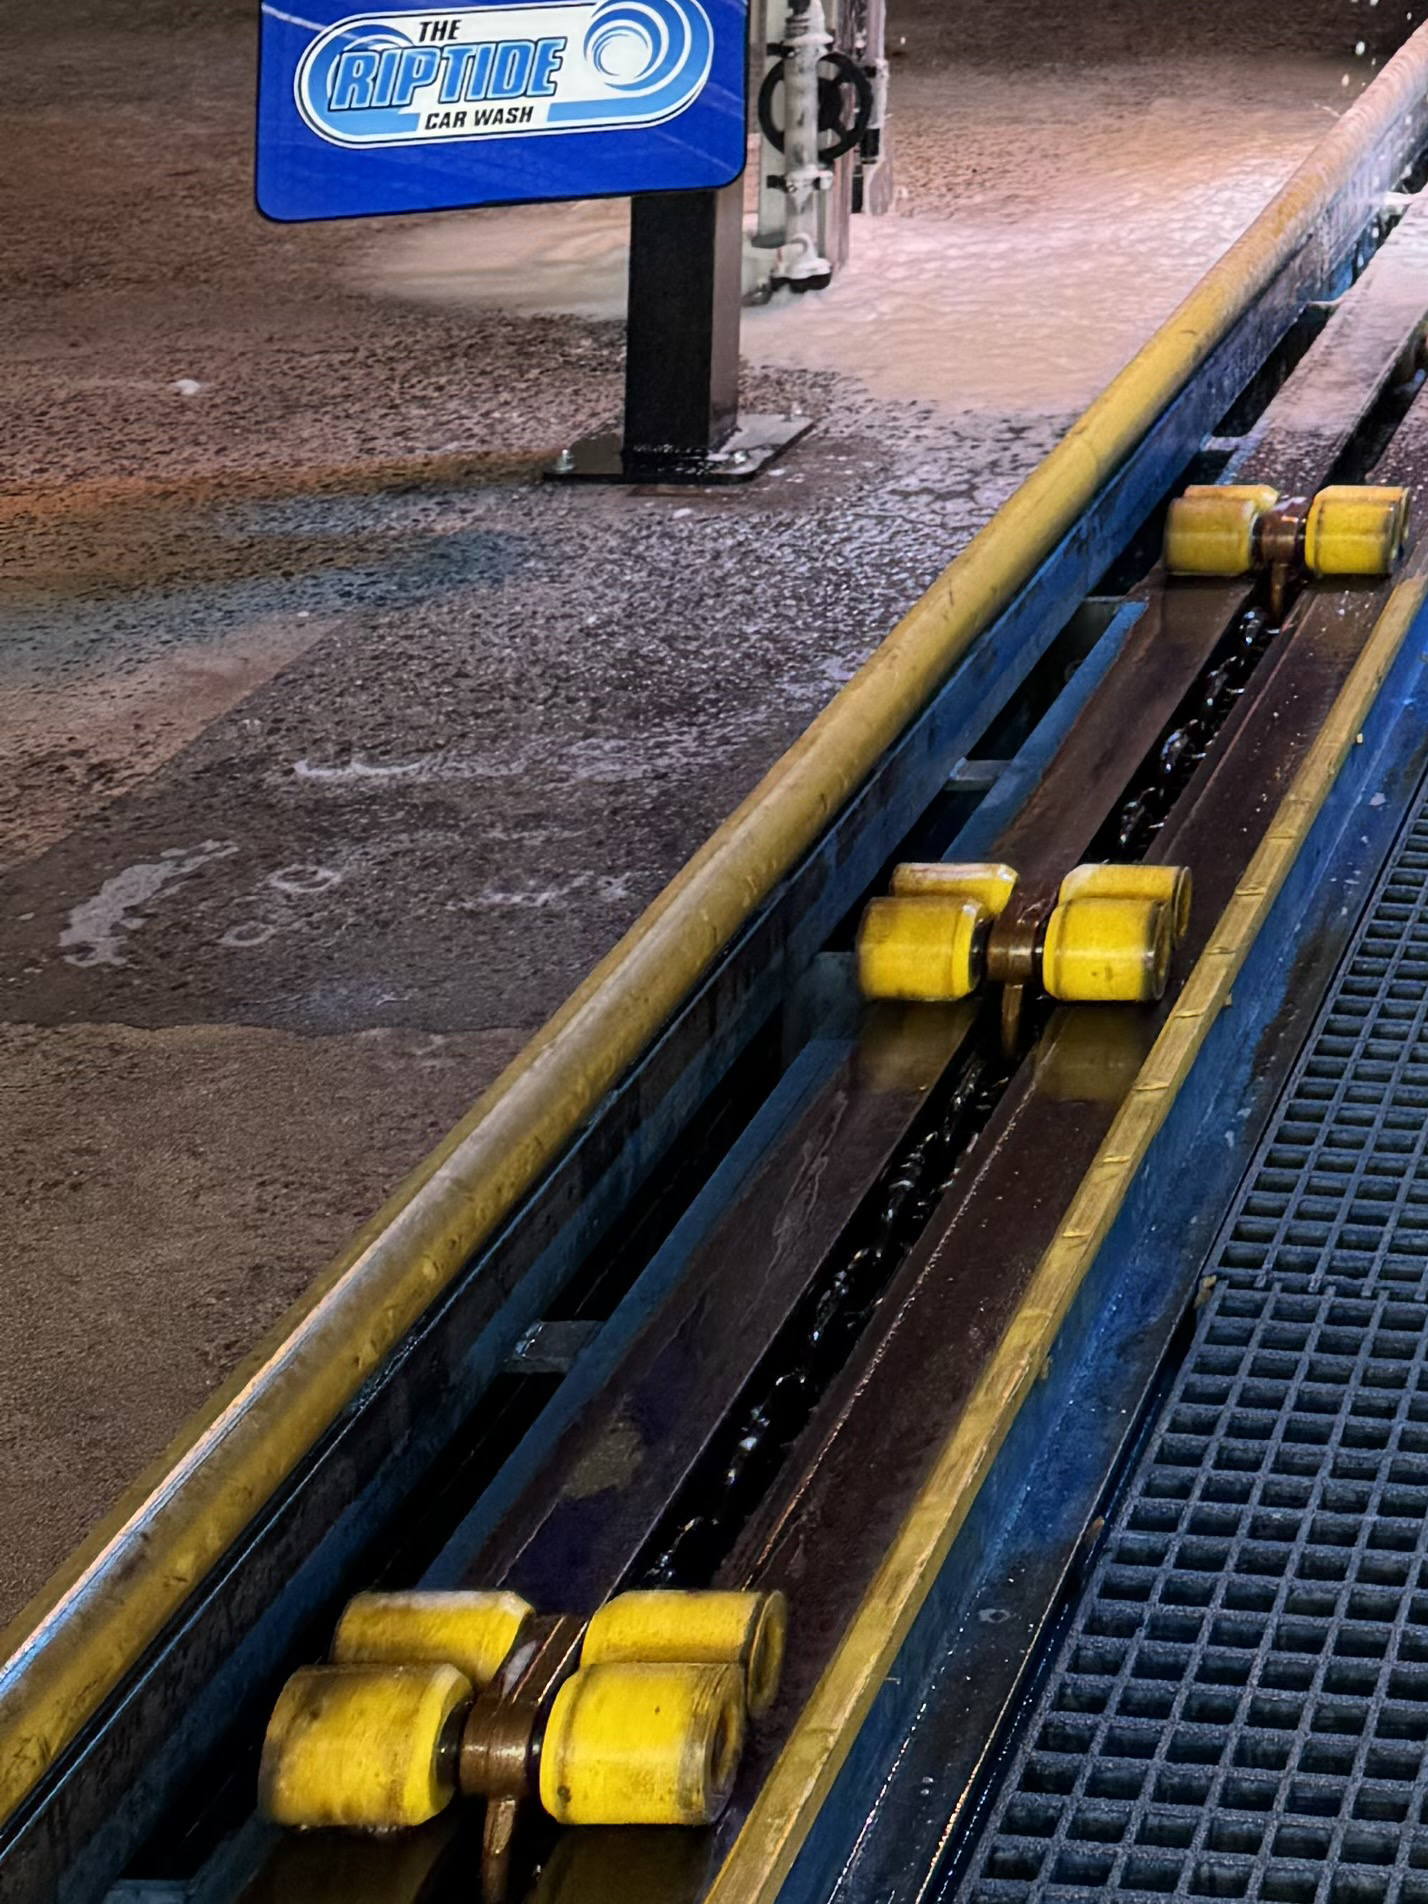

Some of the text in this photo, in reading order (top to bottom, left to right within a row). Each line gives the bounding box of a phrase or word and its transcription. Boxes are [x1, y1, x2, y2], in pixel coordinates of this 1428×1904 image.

[419, 19, 461, 42] THE
[328, 37, 567, 112] RIPTIDE
[424, 106, 534, 131] CAR WASH
